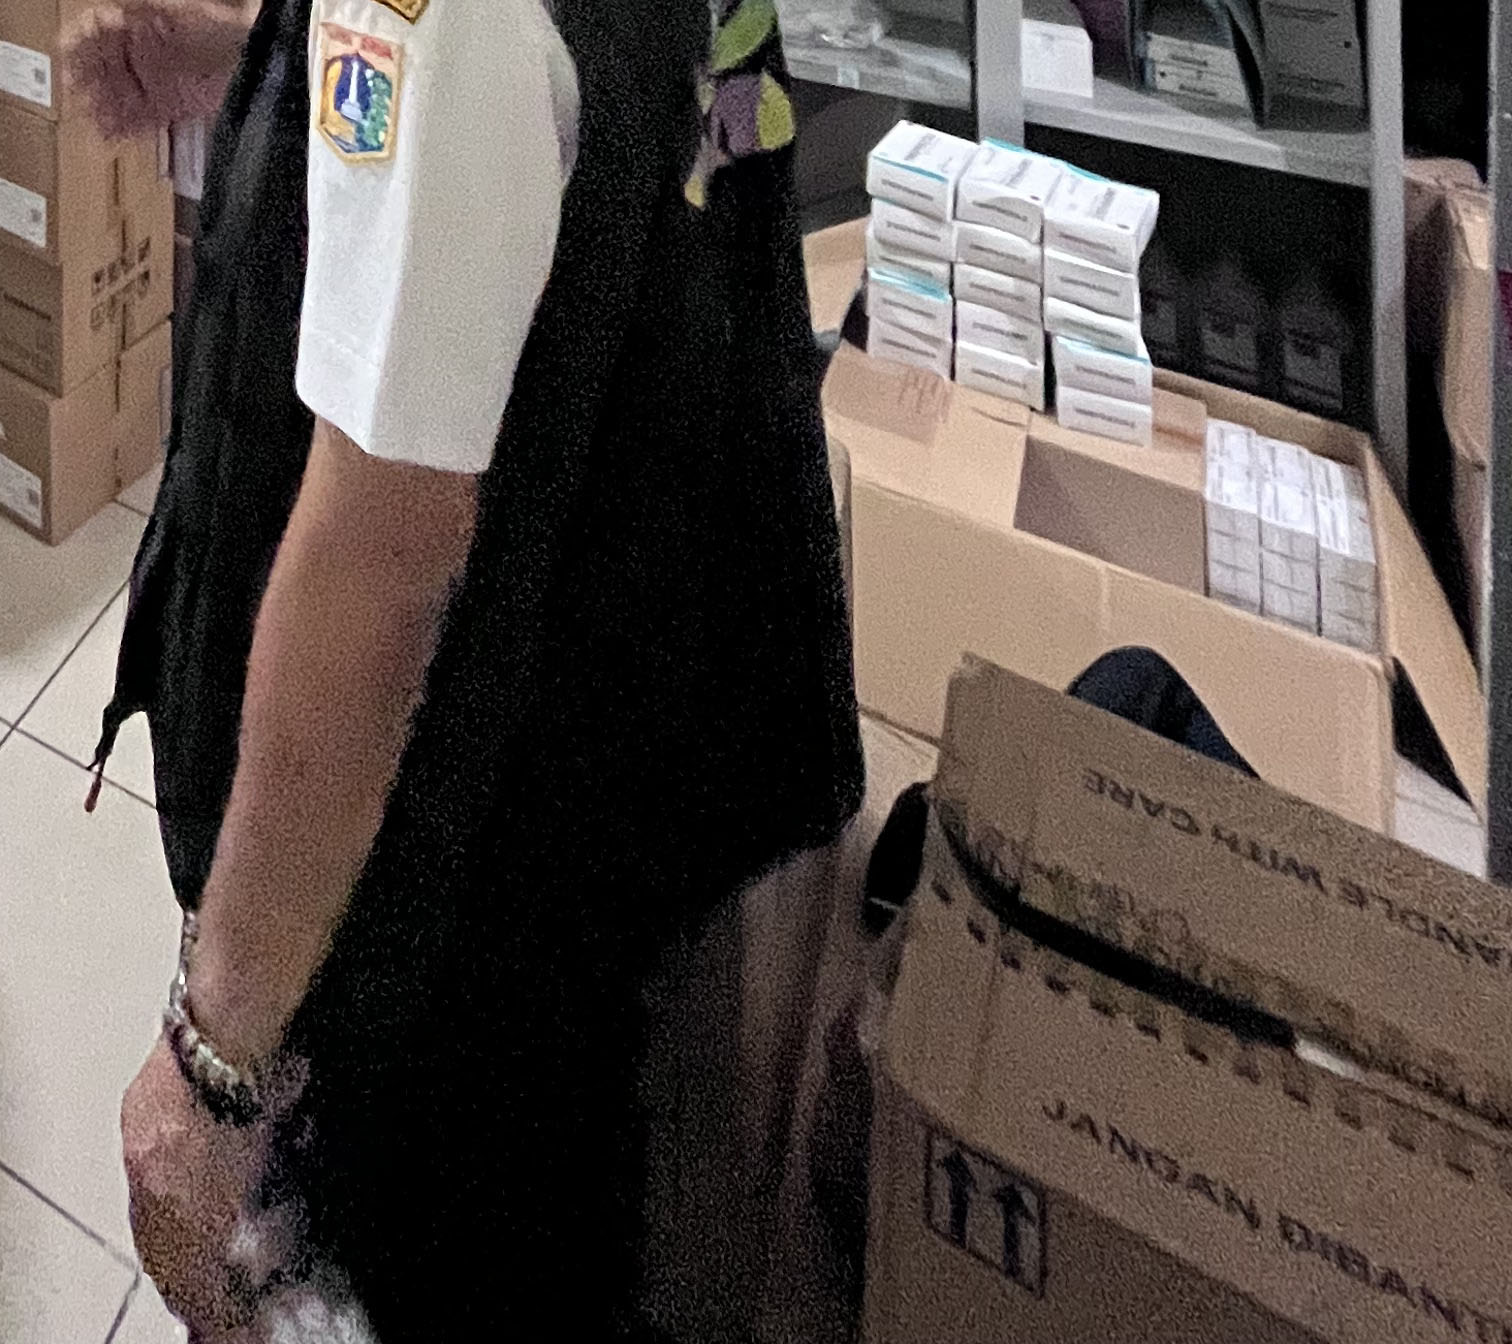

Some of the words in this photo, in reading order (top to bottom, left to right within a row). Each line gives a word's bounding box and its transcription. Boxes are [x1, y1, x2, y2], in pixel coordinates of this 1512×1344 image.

[1084, 767, 1201, 838] CARE
[1210, 822, 1329, 896] WITH
[1336, 875, 1512, 974] ANDLE
[1041, 1099, 1261, 1230] JANGAN
